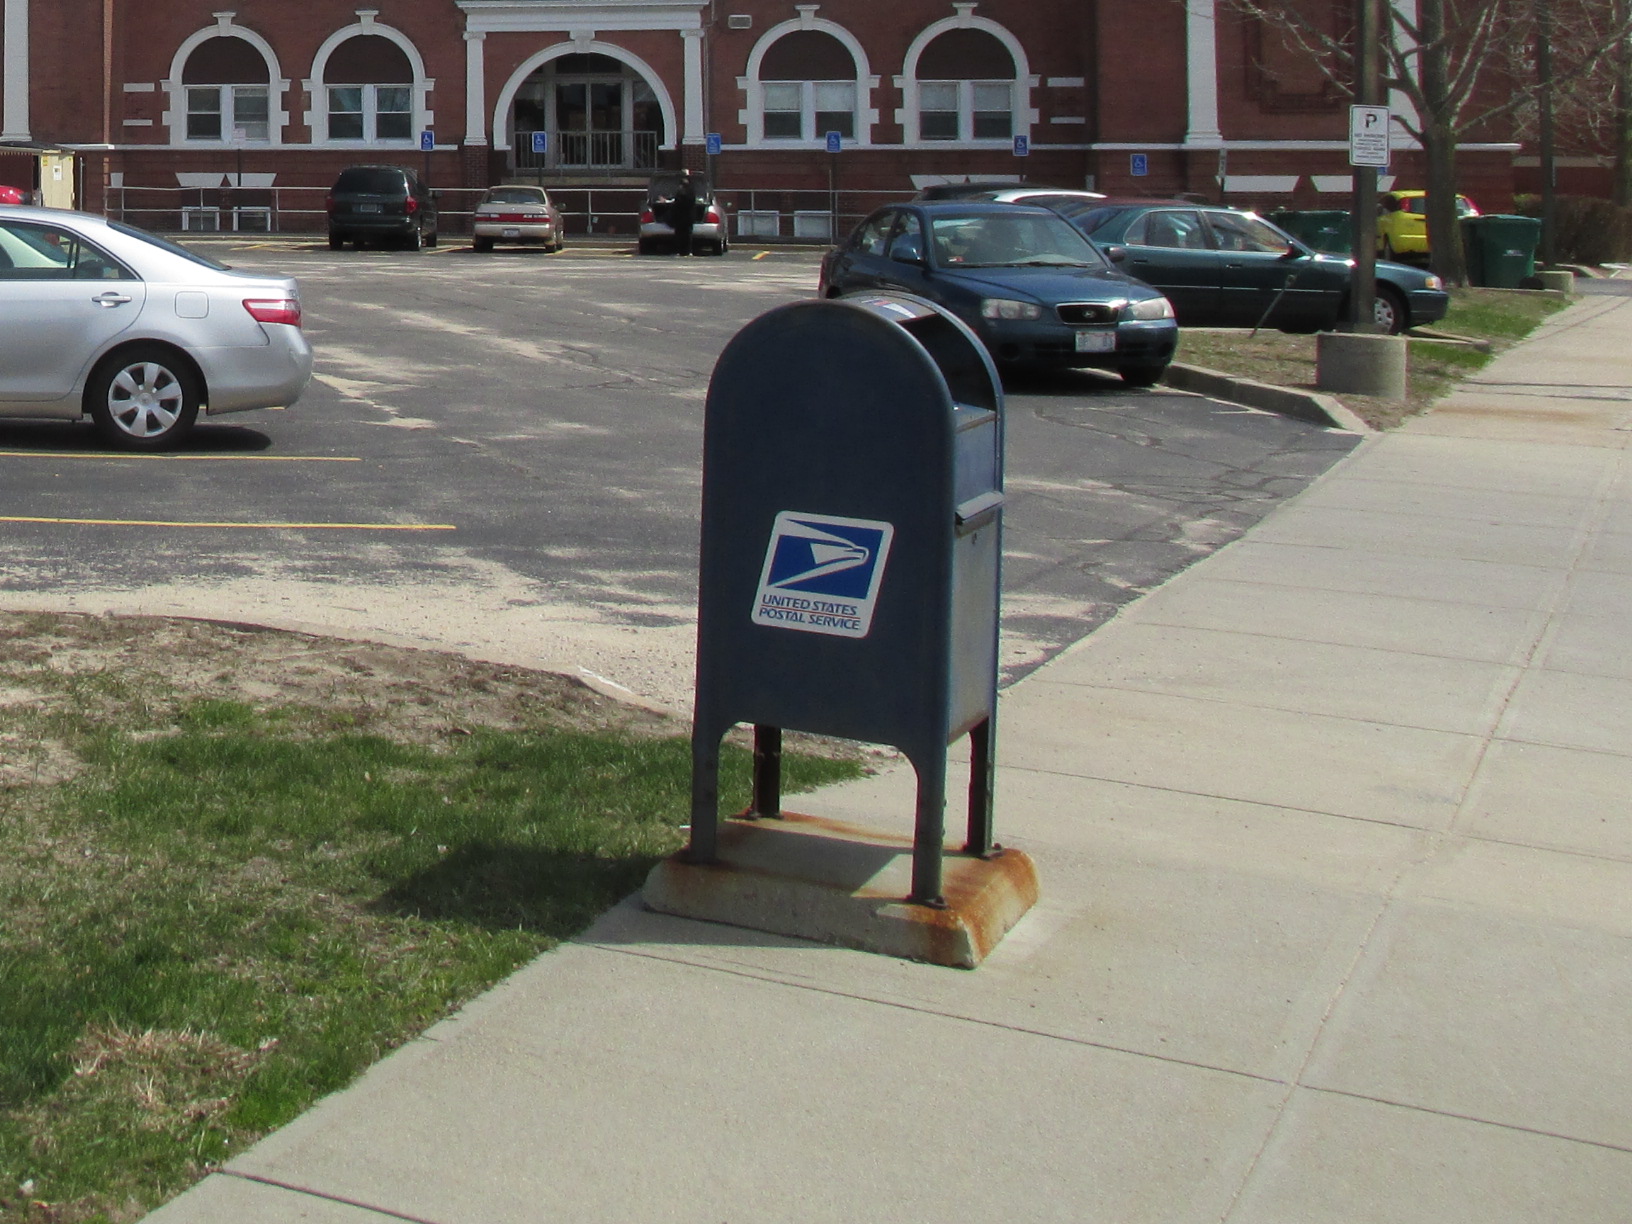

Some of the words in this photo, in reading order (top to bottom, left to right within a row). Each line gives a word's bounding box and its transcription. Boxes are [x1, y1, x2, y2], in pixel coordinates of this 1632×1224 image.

[762, 594, 810, 609] UNITED
[812, 601, 858, 615] STATES
[759, 608, 805, 623] POSTAL
[808, 614, 861, 630] SERVICE
